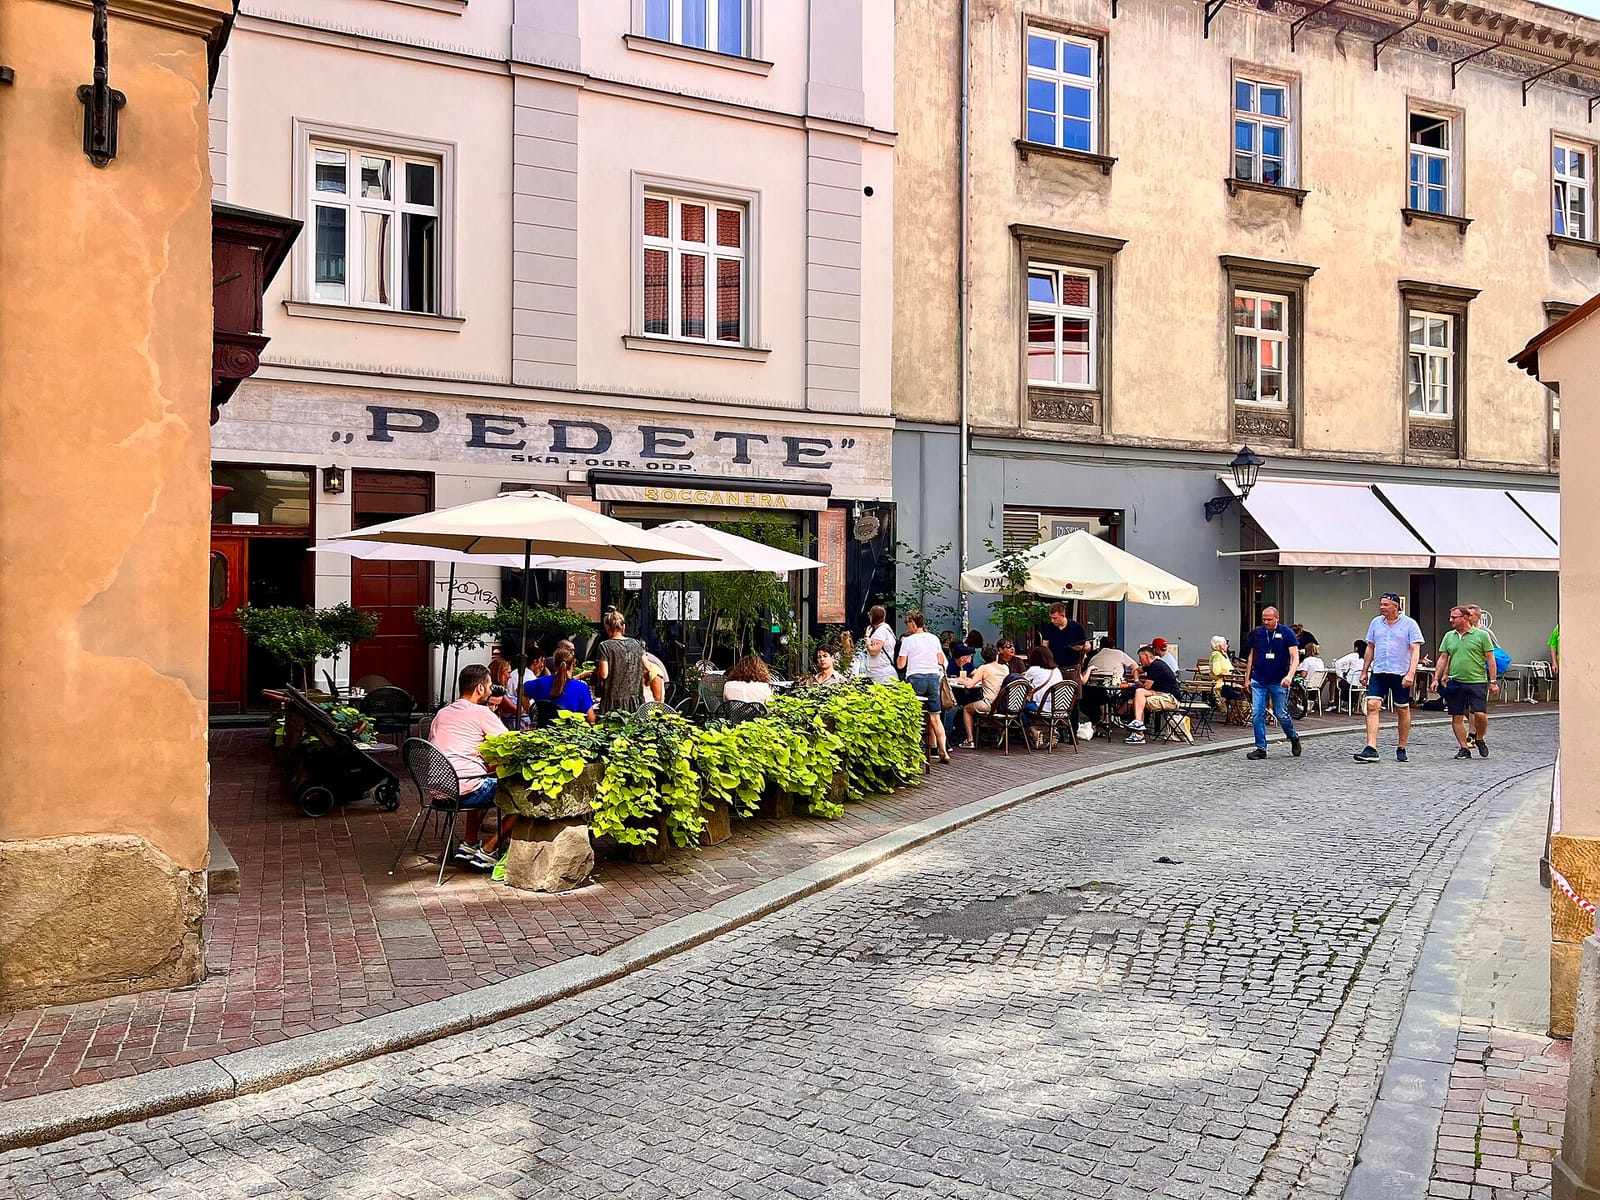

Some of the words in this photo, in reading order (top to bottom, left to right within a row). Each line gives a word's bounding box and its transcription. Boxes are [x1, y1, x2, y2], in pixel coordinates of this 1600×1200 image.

[511, 454, 560, 465] SKA
[585, 458, 636, 469] OGR.
[646, 462, 697, 472] ODP.
[644, 487, 787, 508] BOCCANERA
[1148, 590, 1171, 601] DYM
